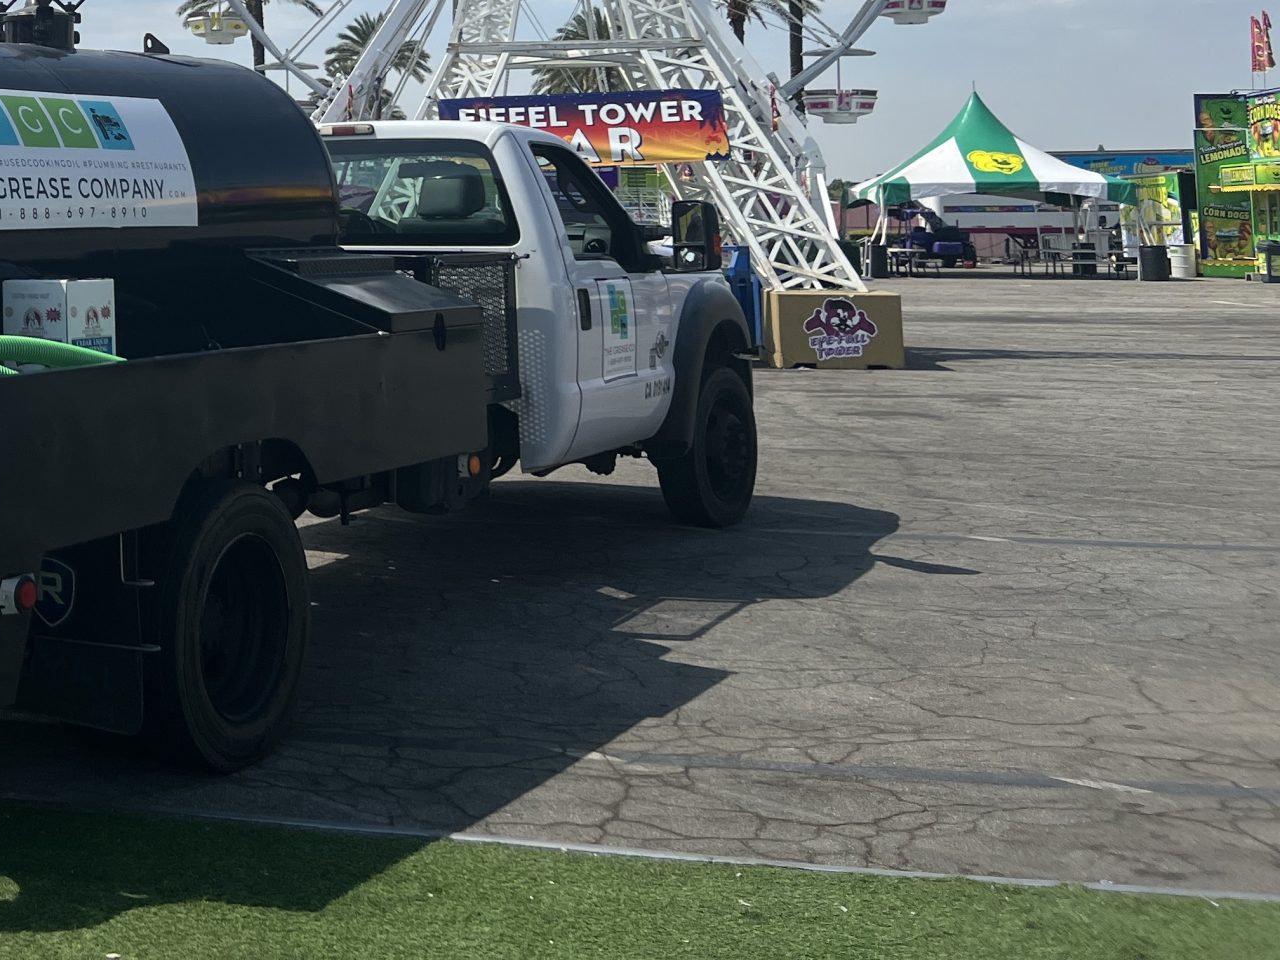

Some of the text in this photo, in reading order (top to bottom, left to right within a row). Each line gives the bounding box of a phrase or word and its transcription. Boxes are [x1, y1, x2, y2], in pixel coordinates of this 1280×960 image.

[577, 100, 704, 126] TOWER
[1200, 145, 1247, 164] LEMONADE
[83, 159, 129, 169] #PLUMBING
[131, 162, 187, 171] #RESTAURANTS
[77, 178, 164, 199] COMPANY
[1203, 206, 1226, 218] CORN
[1227, 210, 1250, 220] DOGS
